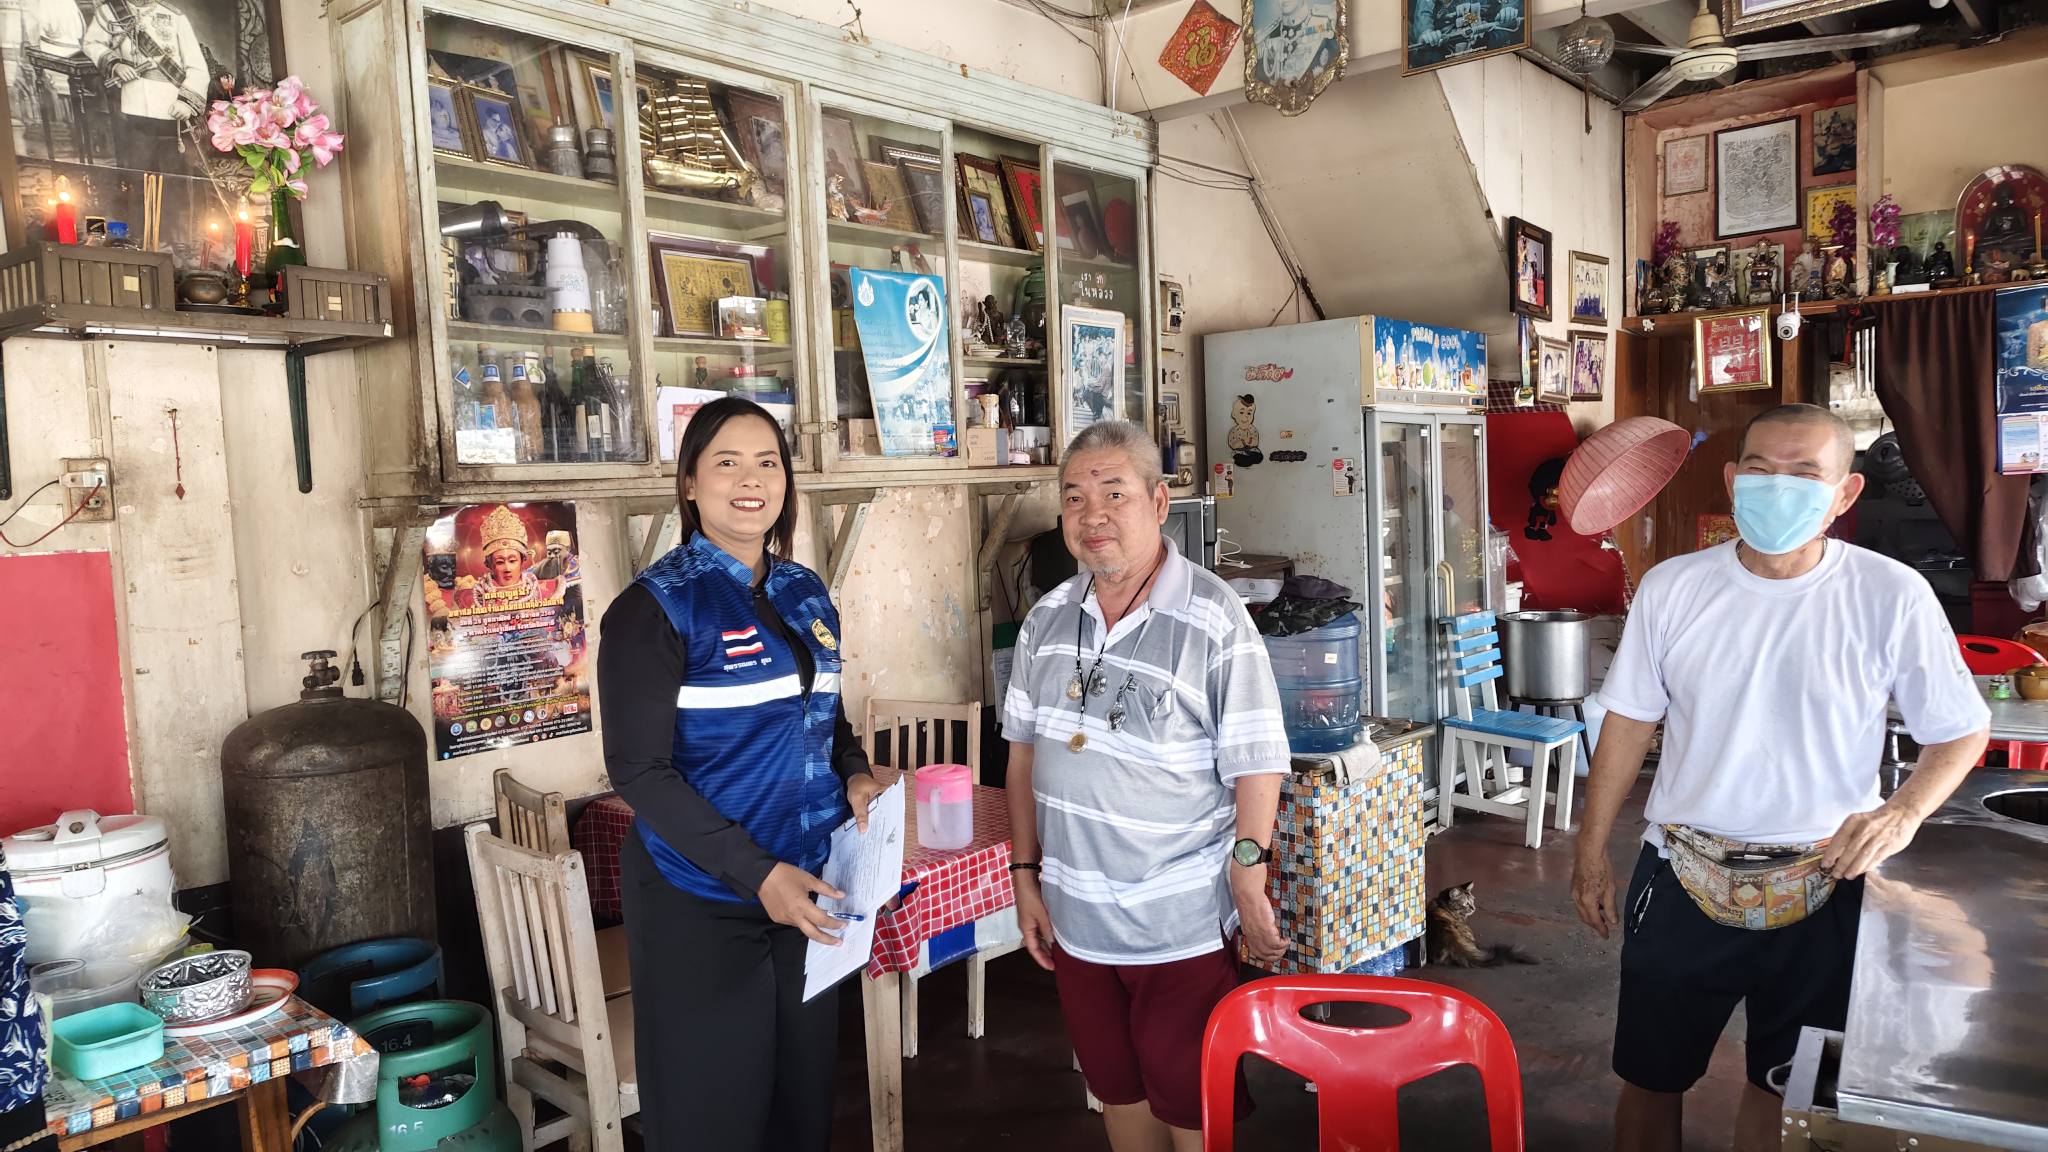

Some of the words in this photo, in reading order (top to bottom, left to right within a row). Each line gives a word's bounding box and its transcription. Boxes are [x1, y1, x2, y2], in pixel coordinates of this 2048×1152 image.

[1185, 25, 1217, 69] 福
[1081, 272, 1092, 282] เรา
[1078, 280, 1114, 300] ในหลวง
[382, 1033, 413, 1053] 16.4
[389, 1120, 424, 1136] 165
